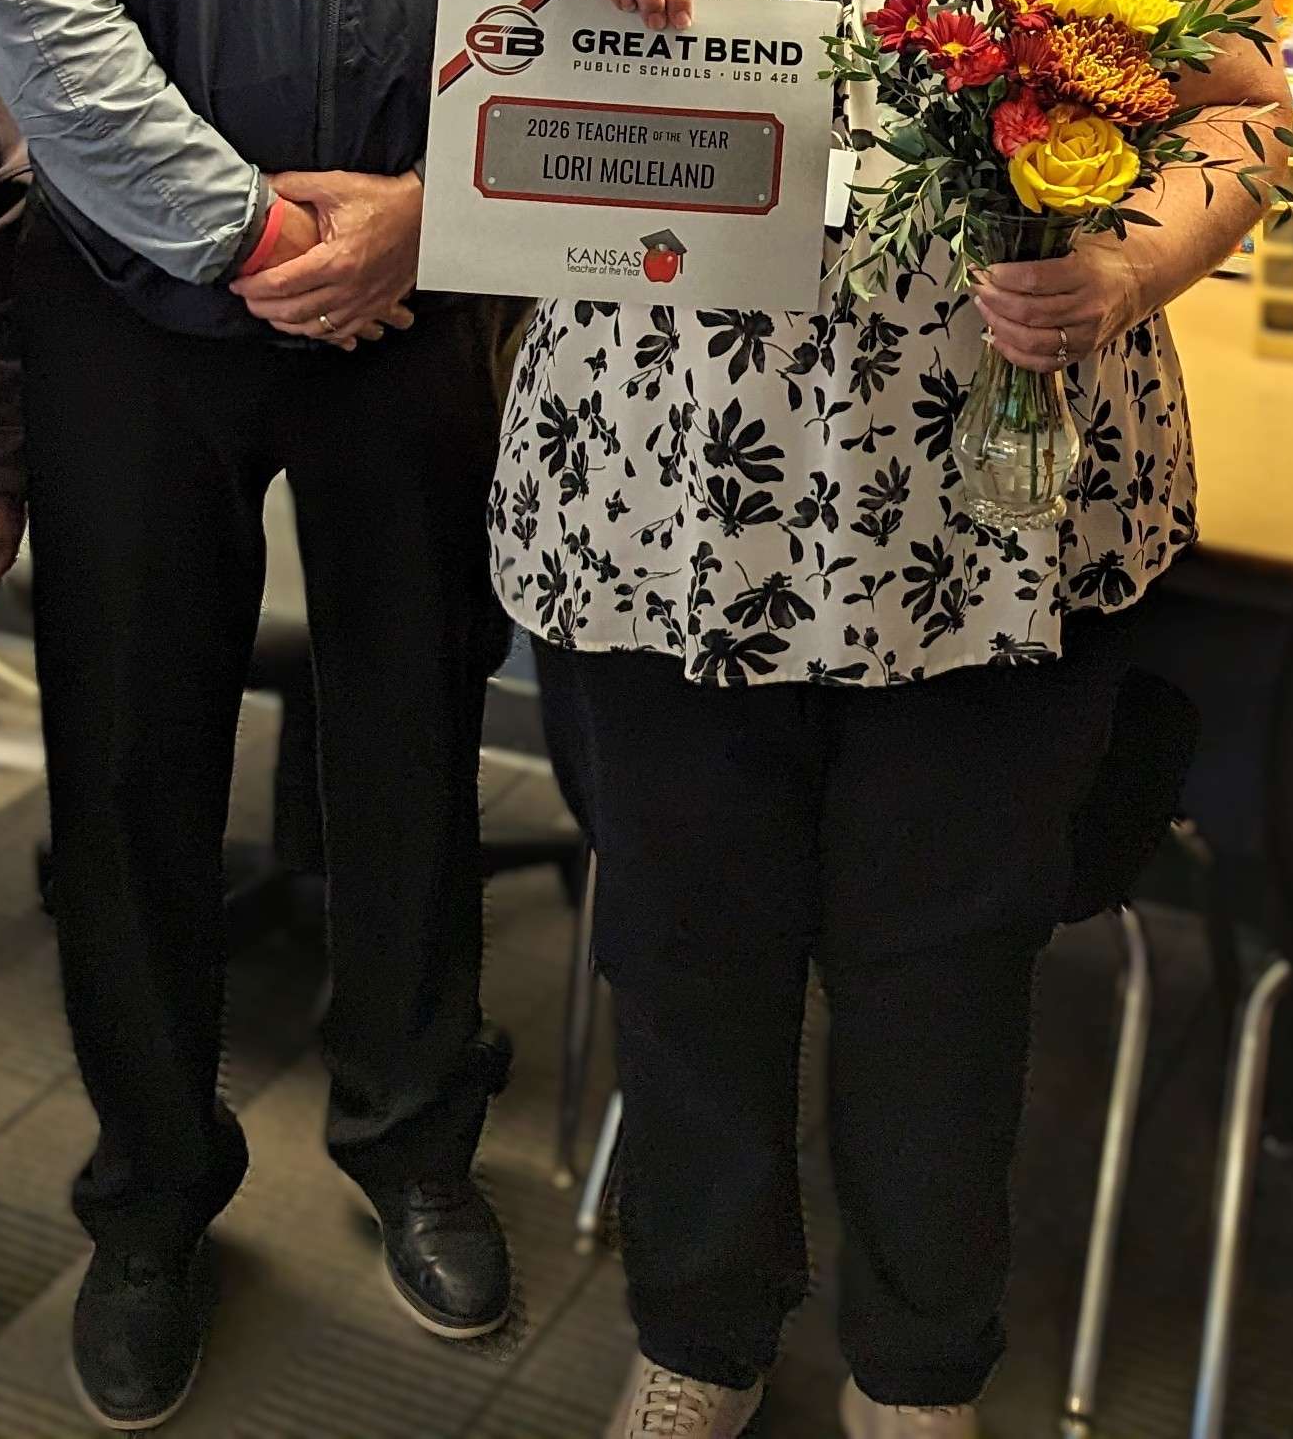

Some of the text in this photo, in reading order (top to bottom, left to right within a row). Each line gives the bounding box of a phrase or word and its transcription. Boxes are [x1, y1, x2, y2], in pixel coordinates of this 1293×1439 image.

[465, 24, 545, 57] GB
[572, 29, 803, 66] GREAT BEND
[573, 60, 798, 83] PUBLIC SCHOOLS USD 428
[527, 118, 729, 150] 2026 TEACHER OF THE YEAR
[542, 153, 716, 190] LORI MCLELAND
[567, 247, 642, 267] KANSAS
[567, 263, 597, 274] Teacher
[598, 266, 608, 275] of
[622, 267, 640, 277] Year
